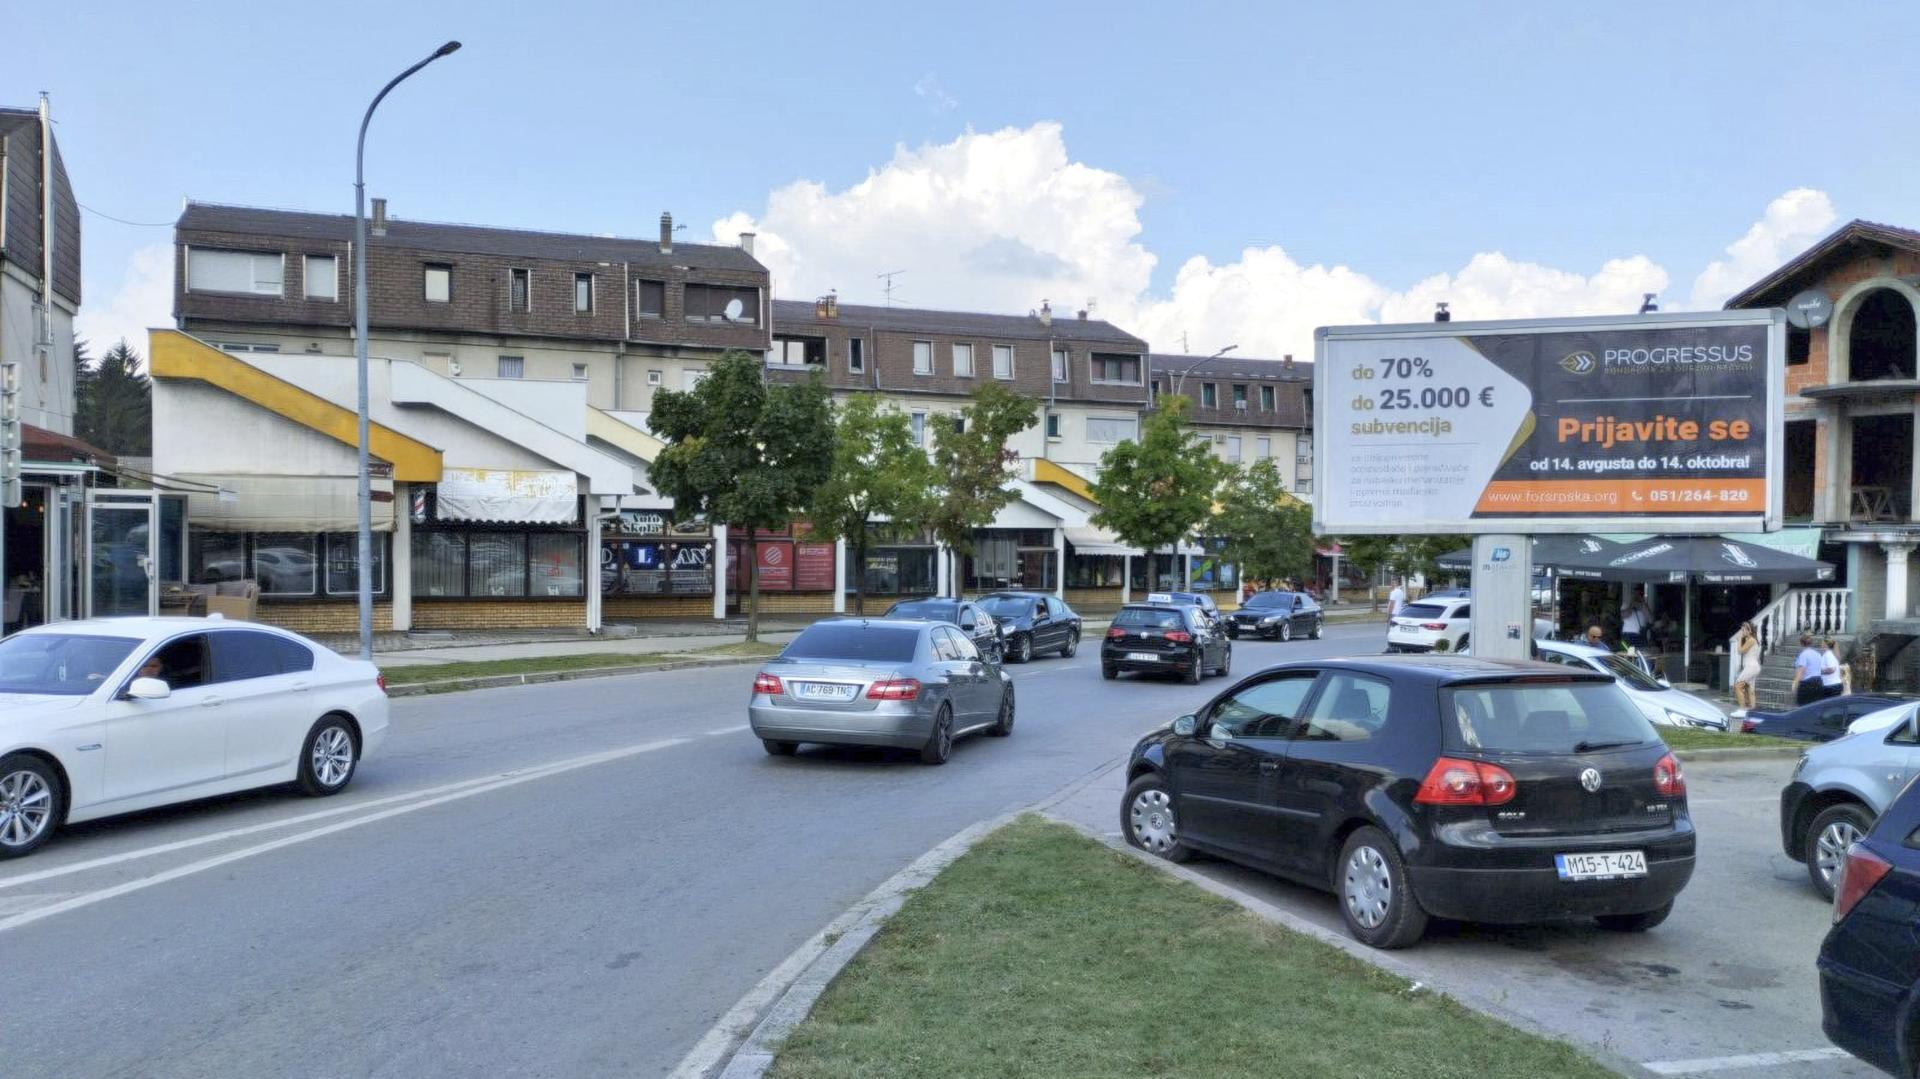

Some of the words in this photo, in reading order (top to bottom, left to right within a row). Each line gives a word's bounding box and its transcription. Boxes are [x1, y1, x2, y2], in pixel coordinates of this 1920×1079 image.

[1604, 345, 1753, 366] PROGRESSUS
[1351, 364, 1375, 380] do
[1379, 357, 1434, 379] 70%
[1351, 395, 1375, 411] do
[1379, 387, 1470, 410] 25.000
[1478, 386, 1495, 408] €
[1351, 417, 1452, 437] subvencija
[1558, 415, 1699, 449] Prijavite
[1708, 419, 1750, 440] se
[1530, 458, 1549, 471] od
[1552, 457, 1574, 471] 14.
[1577, 457, 1635, 473] avgusta
[1638, 456, 1656, 470] do
[1660, 456, 1683, 470] 14.
[1687, 455, 1750, 470] oktobra!
[1650, 489, 1749, 502] 051/264-820
[1566, 852, 1645, 874] M15-T-424
